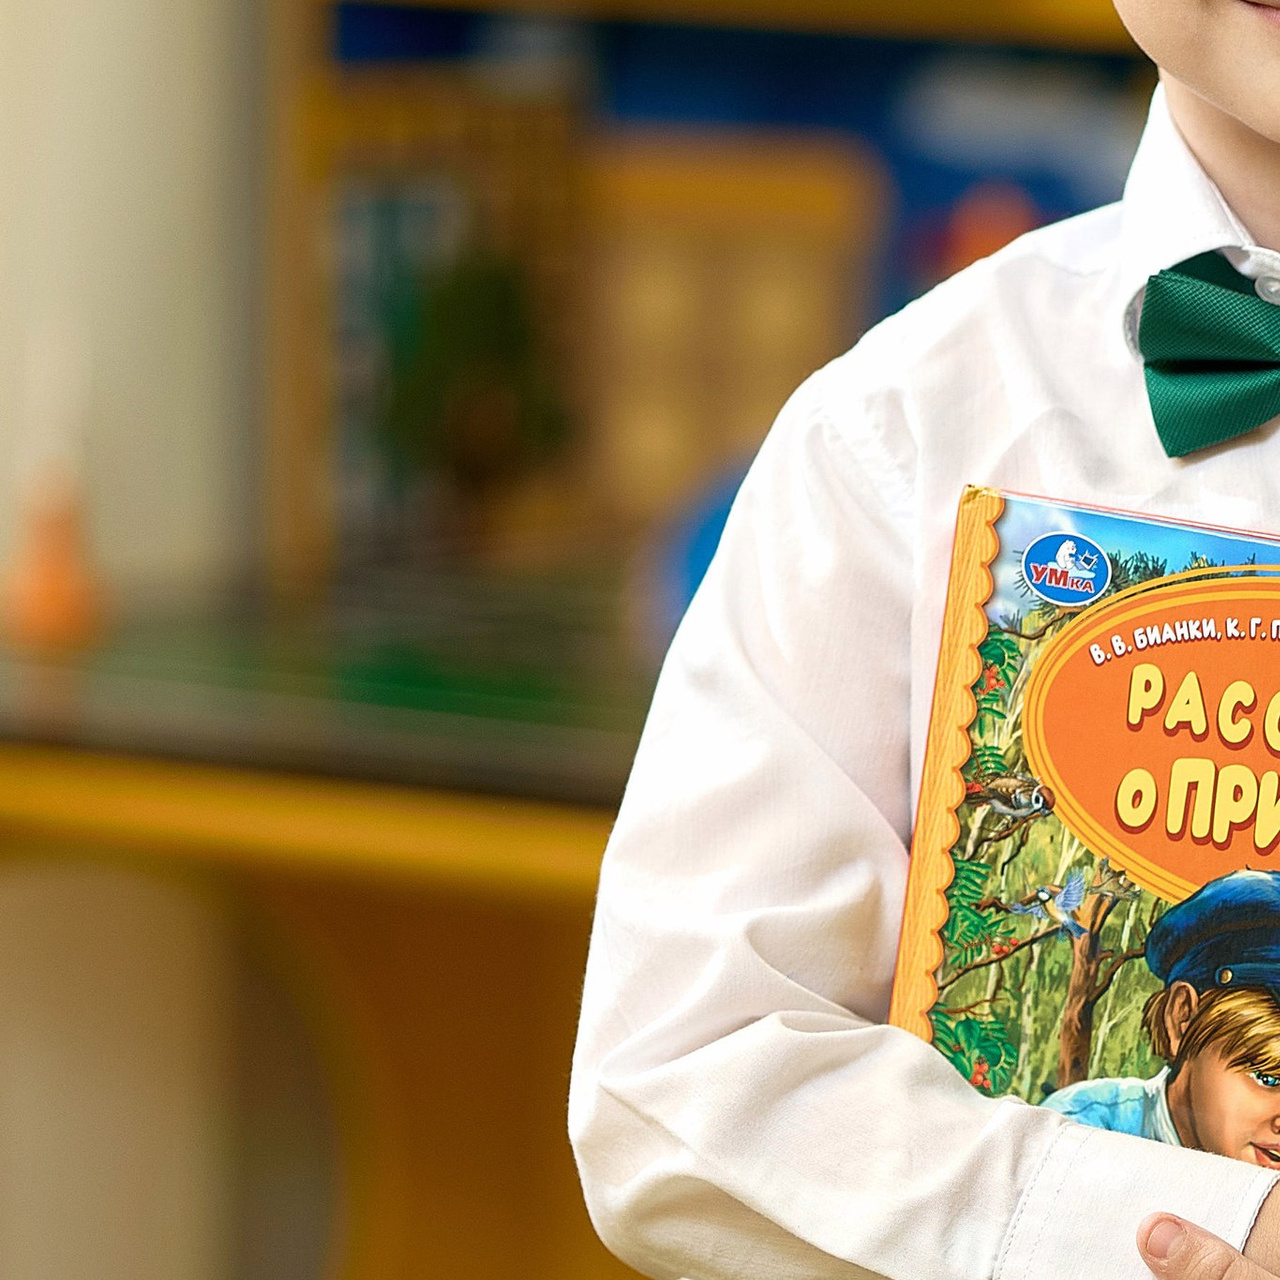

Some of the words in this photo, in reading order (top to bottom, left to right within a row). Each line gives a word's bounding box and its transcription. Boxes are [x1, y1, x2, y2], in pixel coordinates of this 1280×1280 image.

[1089, 643, 1112, 665] В.
[1111, 634, 1133, 657] В.
[1133, 617, 1222, 650] БИАНКИ,
[1226, 617, 1246, 638] К.
[1250, 617, 1267, 639] Г.
